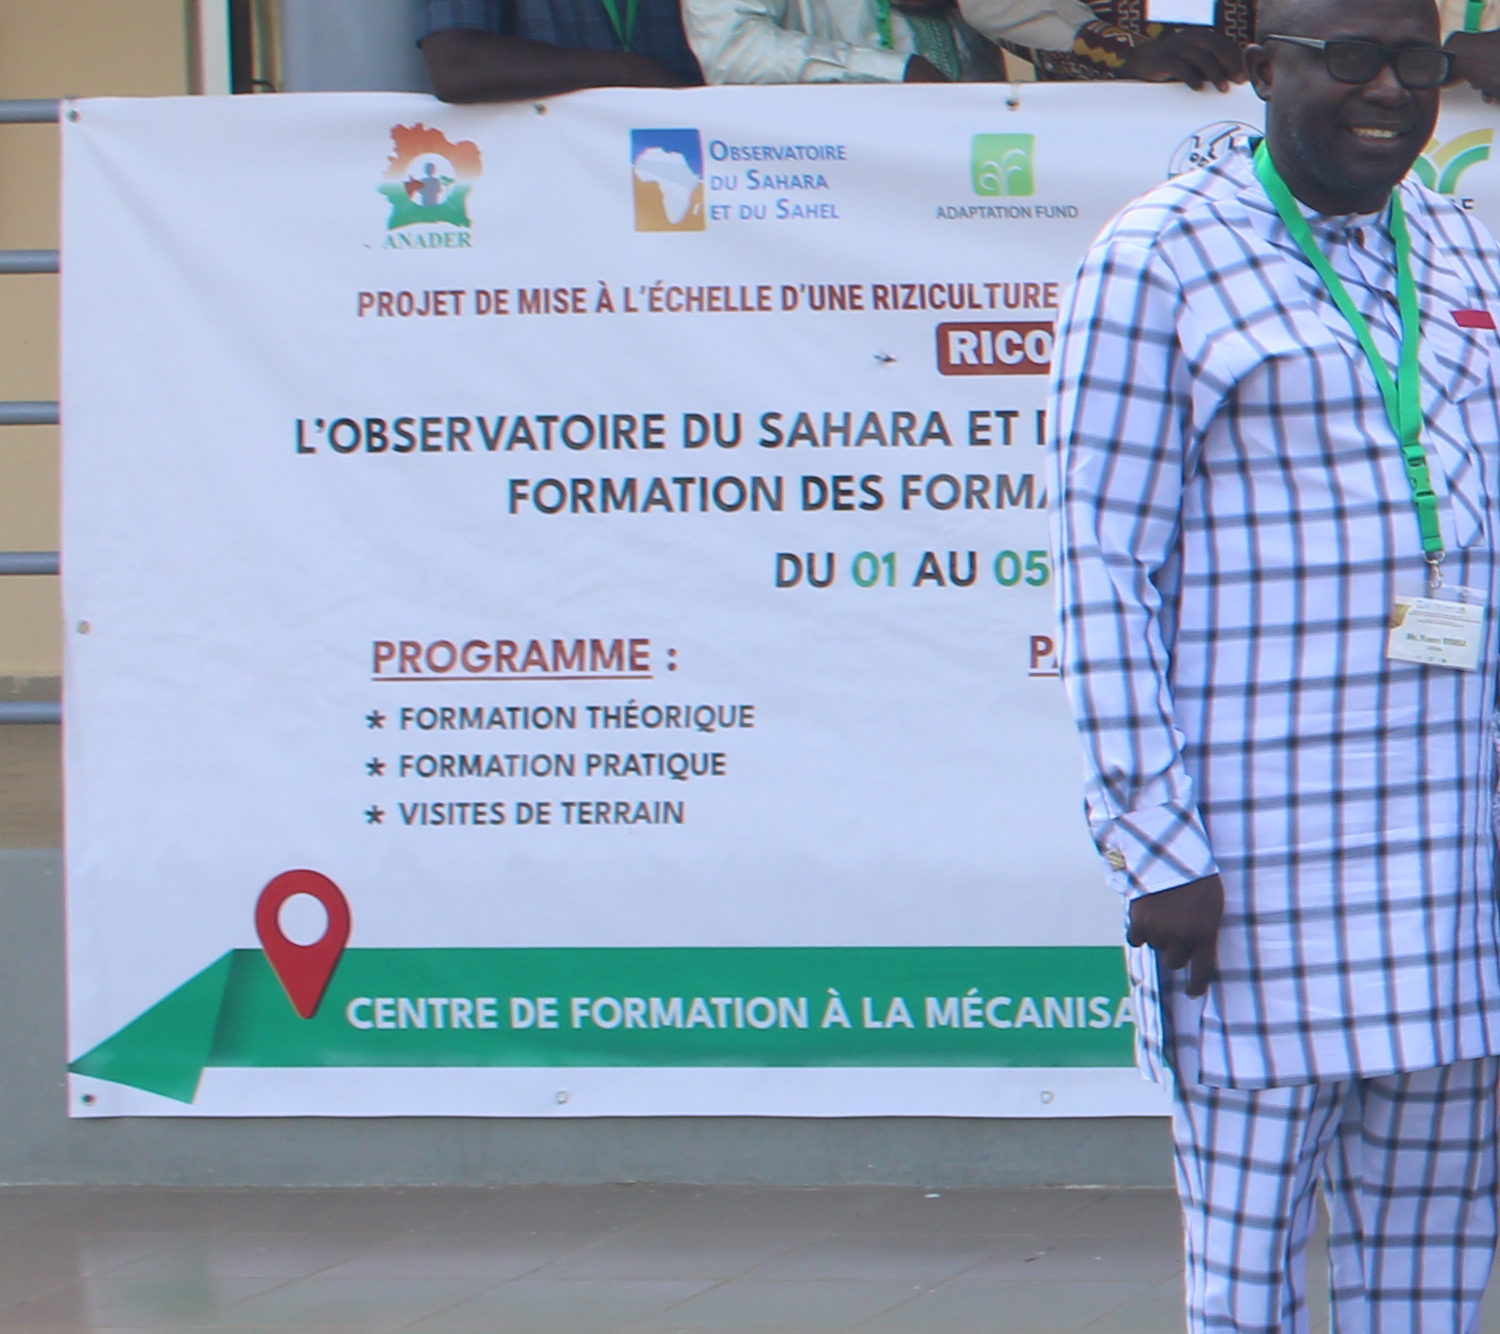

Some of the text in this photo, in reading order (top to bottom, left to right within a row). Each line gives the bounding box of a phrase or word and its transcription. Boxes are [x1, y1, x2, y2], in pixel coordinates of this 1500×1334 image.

[708, 140, 846, 161] OBSERVATOIRE
[710, 169, 828, 190] DU SAHARA
[710, 198, 839, 220] ET DU SAHEL
[936, 205, 1079, 219] ADAPTATION FUND
[384, 229, 472, 249] ANADER
[358, 290, 466, 316] PROJET
[473, 285, 510, 318] DE
[515, 284, 587, 317] MISE
[596, 281, 615, 313] À
[624, 281, 772, 313] L’ÉCHELLE
[781, 284, 864, 311] D’UNE
[872, 280, 1058, 309] RIZICULTURE
[295, 414, 665, 454] L’OBSERVATOIRE
[683, 413, 742, 448] DU
[758, 411, 952, 448] SAHARA
[968, 410, 1020, 446] ET
[508, 476, 783, 514] FORMATION
[801, 475, 884, 511] DES
[775, 550, 1050, 588] DU 01 AU 05
[373, 636, 651, 674] PROGRAMME
[400, 700, 754, 733] FORMATION THÉORIQUE
[400, 753, 726, 780] FORMATION PRATIQUE
[398, 802, 683, 825] VISITES DE TERRAIN
[346, 998, 498, 1029] CENTRE
[510, 998, 559, 1028] DE
[571, 997, 808, 1028] FORMATION
[821, 988, 852, 1028] À
[862, 997, 914, 1028] LA
